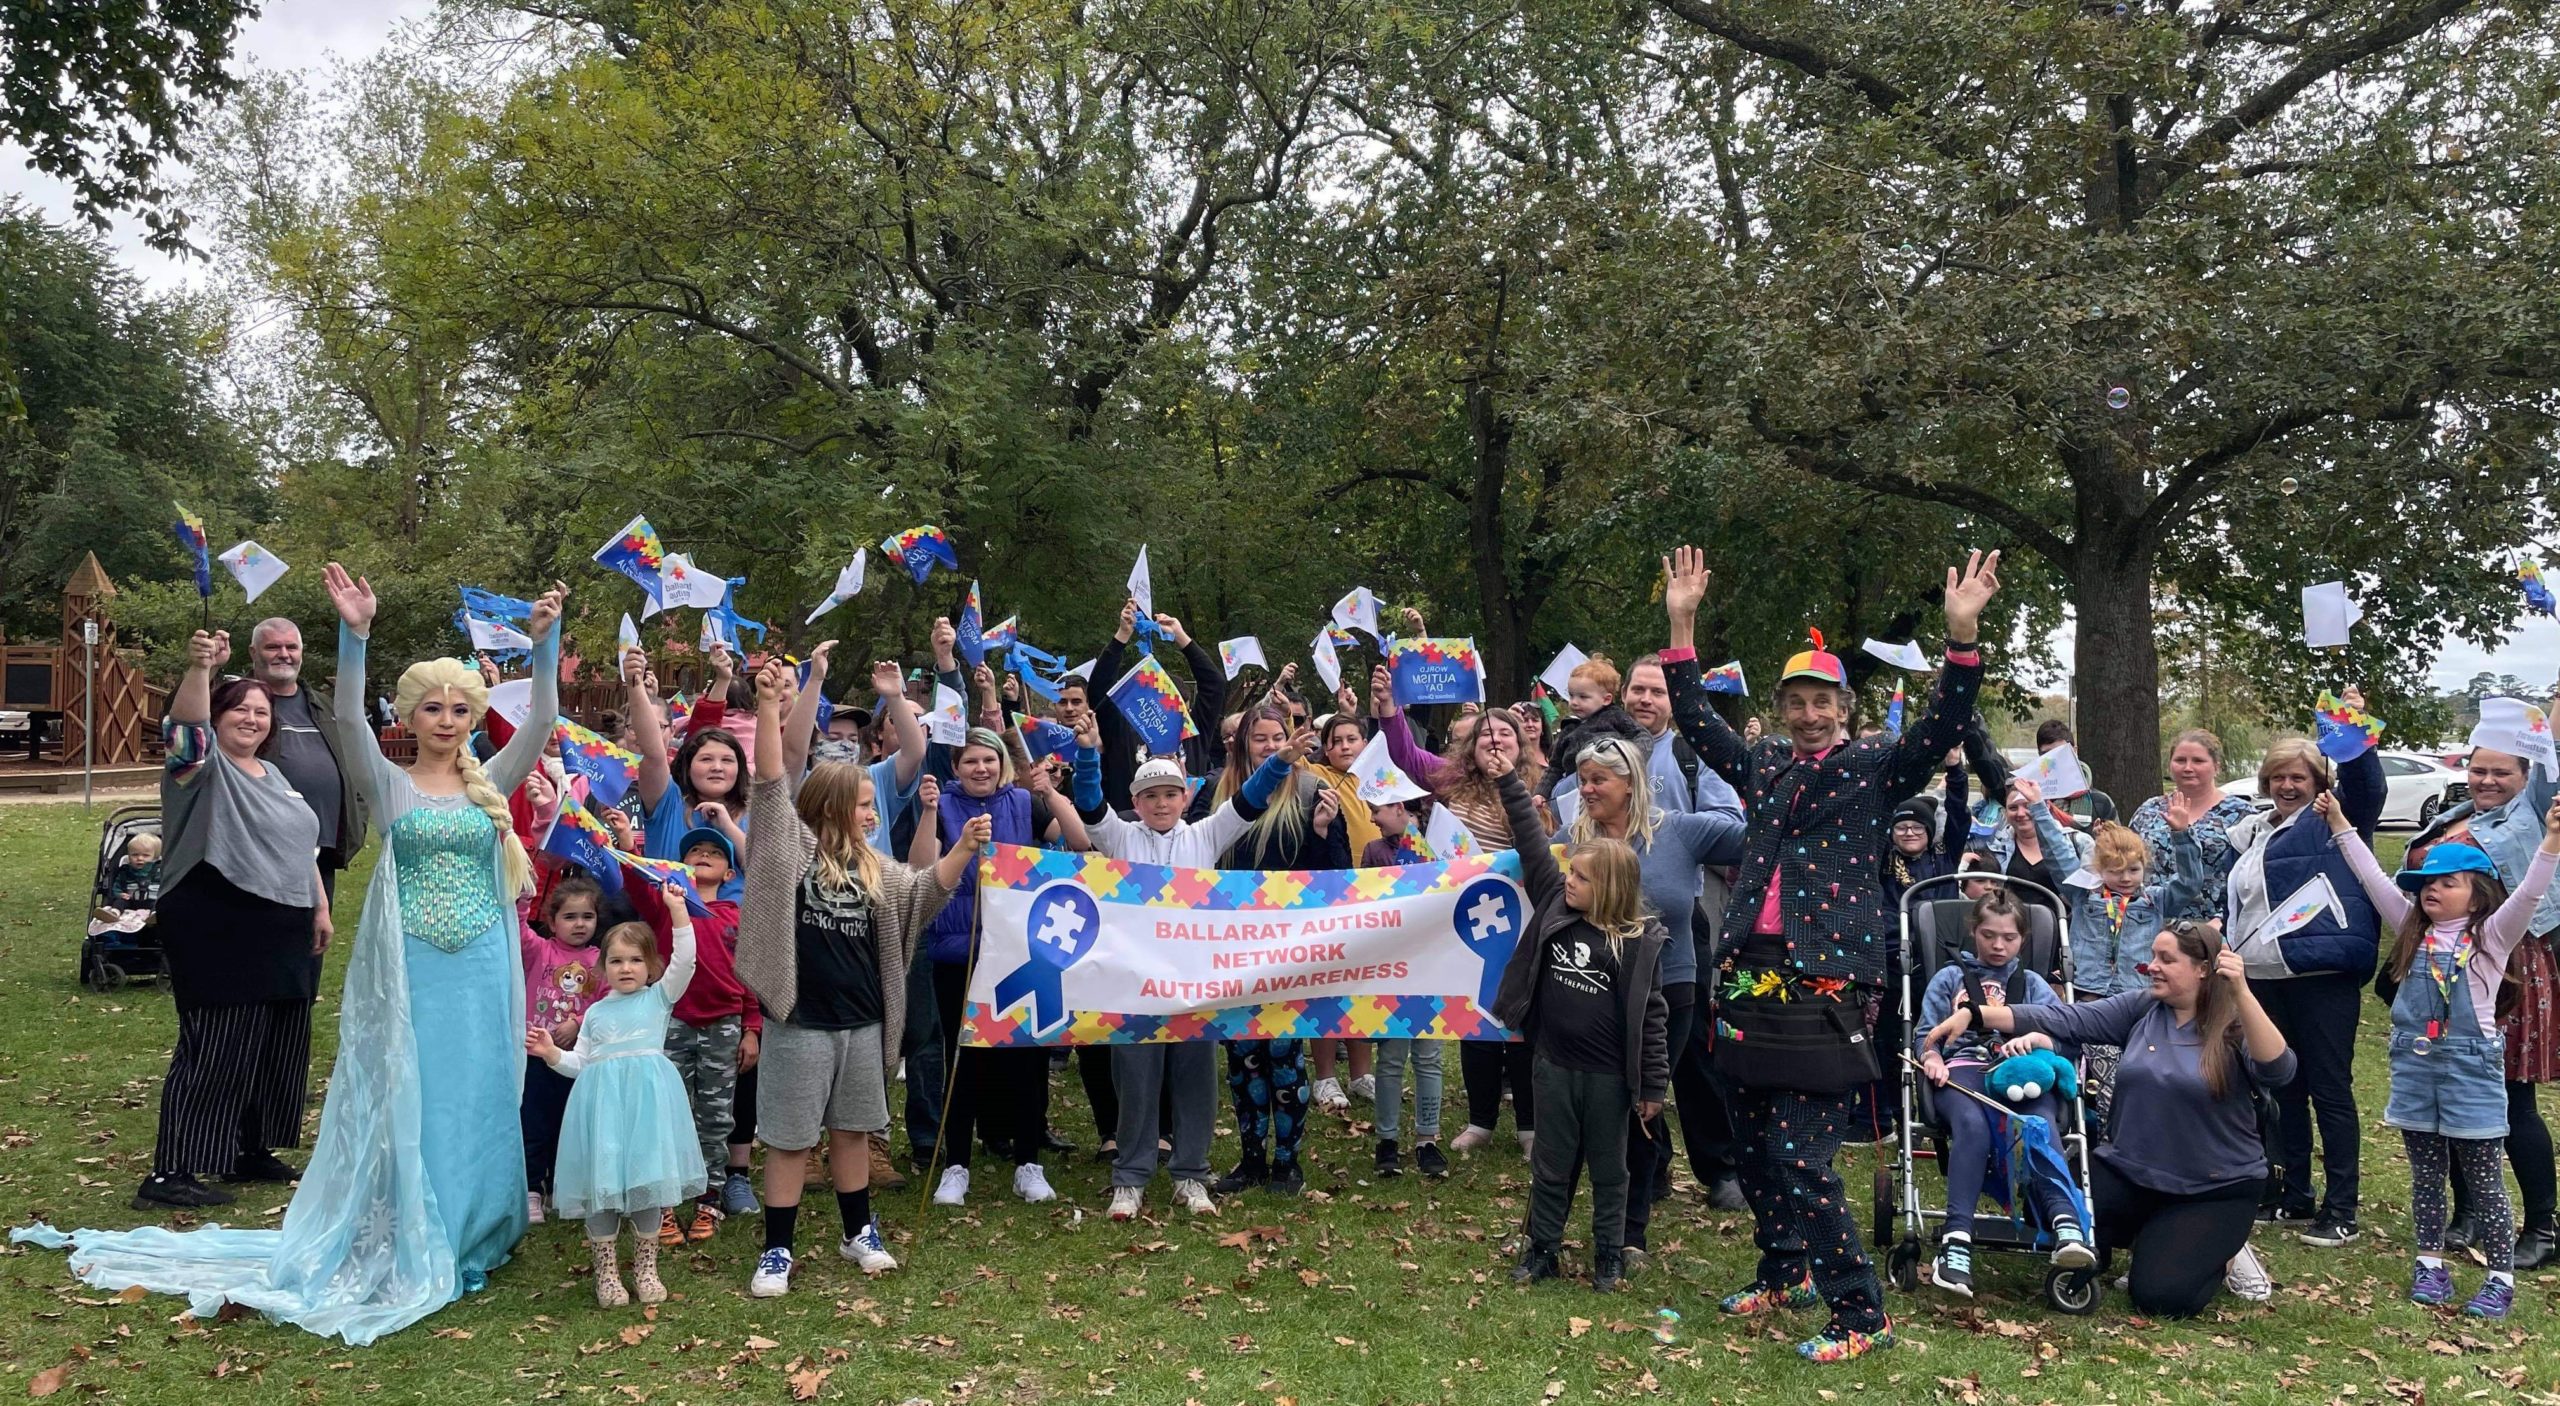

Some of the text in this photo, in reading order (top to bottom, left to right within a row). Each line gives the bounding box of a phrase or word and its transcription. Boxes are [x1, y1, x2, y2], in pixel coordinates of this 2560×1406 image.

[1136, 697, 1168, 736] AUTISM
[1138, 711, 1154, 729] DAY
[1149, 697, 1168, 721] WORLD
[802, 910, 837, 930] ecko
[1155, 909, 1402, 941] BALLARAT AUTISM
[1212, 943, 1347, 969] NETWORK
[1140, 961, 1409, 1000] AUTISM AWARENESS
[1563, 977, 1598, 995] SHEPHERD
